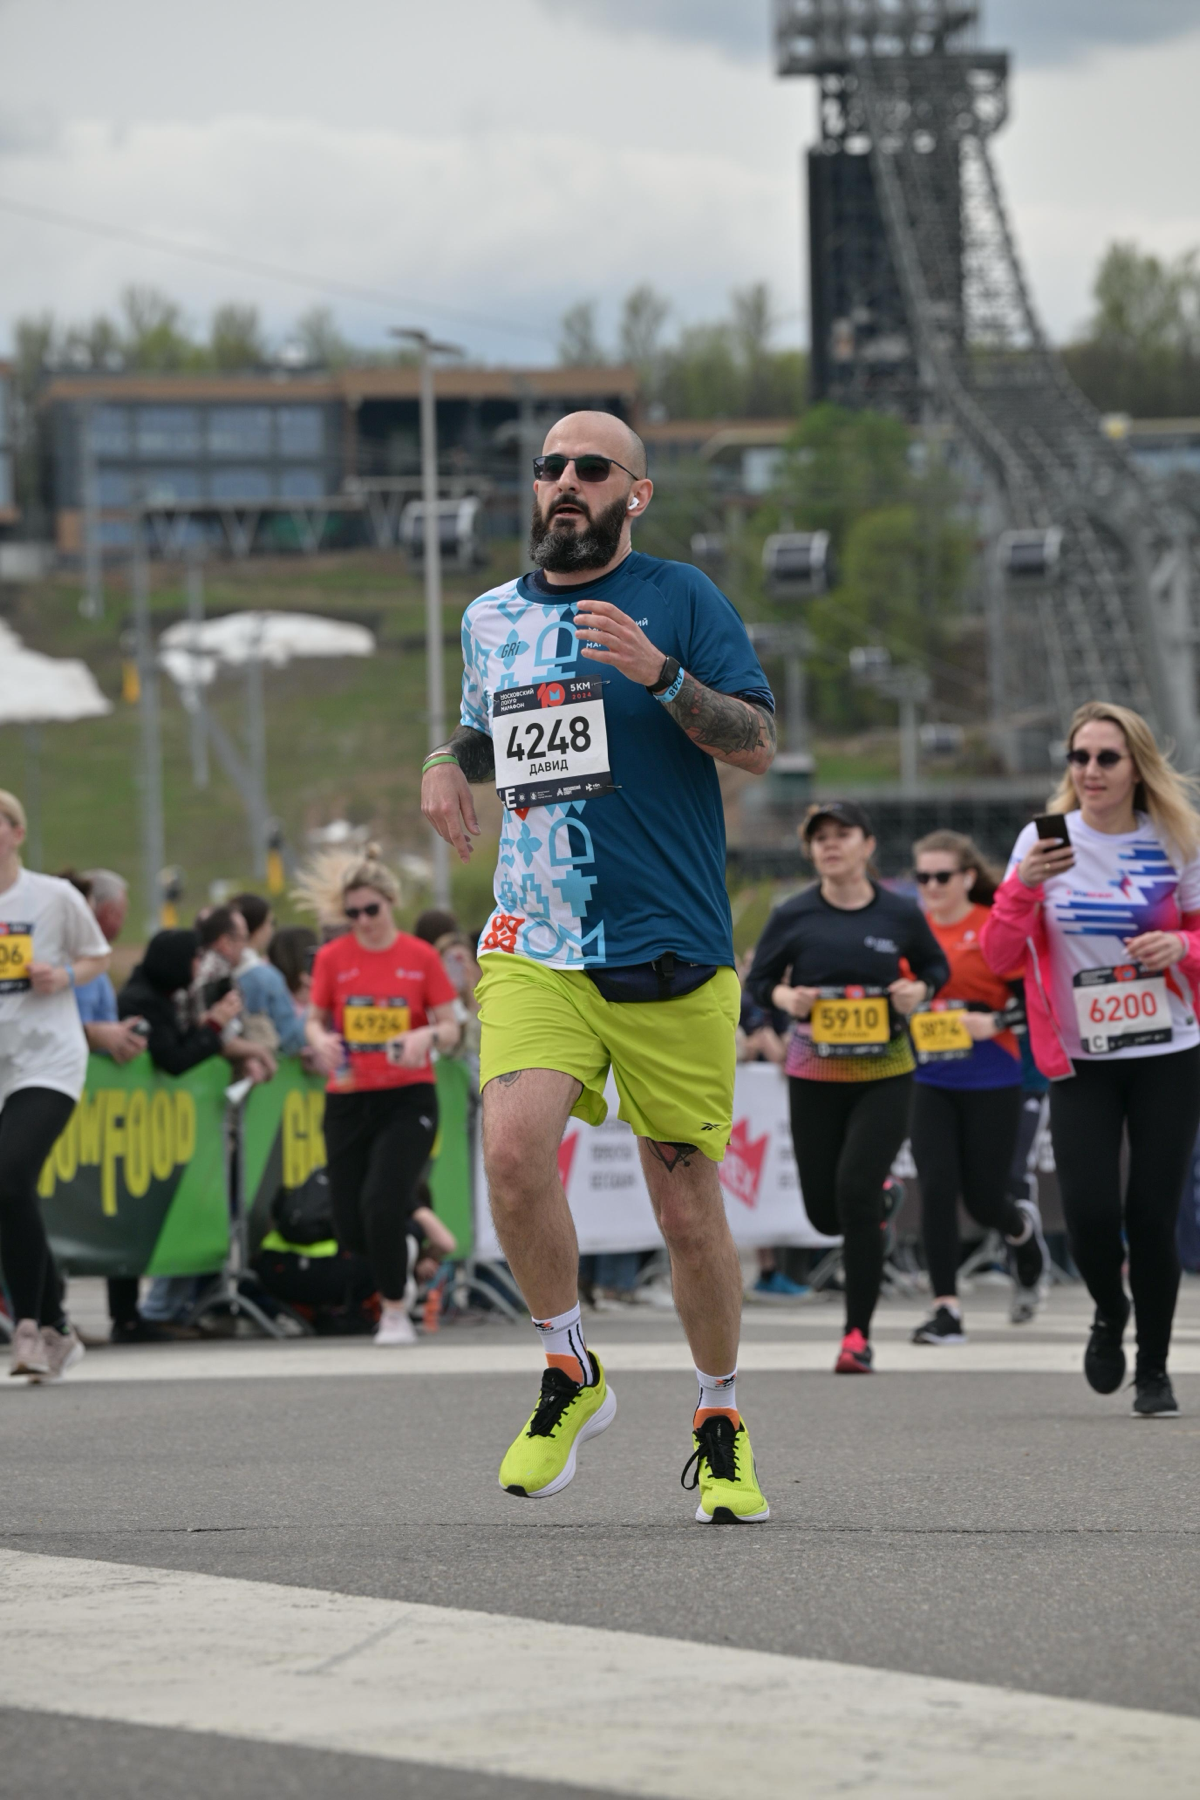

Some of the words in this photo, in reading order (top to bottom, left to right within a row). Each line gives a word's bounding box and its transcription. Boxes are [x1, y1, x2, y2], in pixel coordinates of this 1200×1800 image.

[506, 716, 591, 761] 4248
[529, 759, 568, 775] ДАВИД
[505, 788, 517, 809] E
[1089, 991, 1157, 1023] 6200
[821, 1007, 879, 1030] 5910
[1092, 1035, 1103, 1049] C
